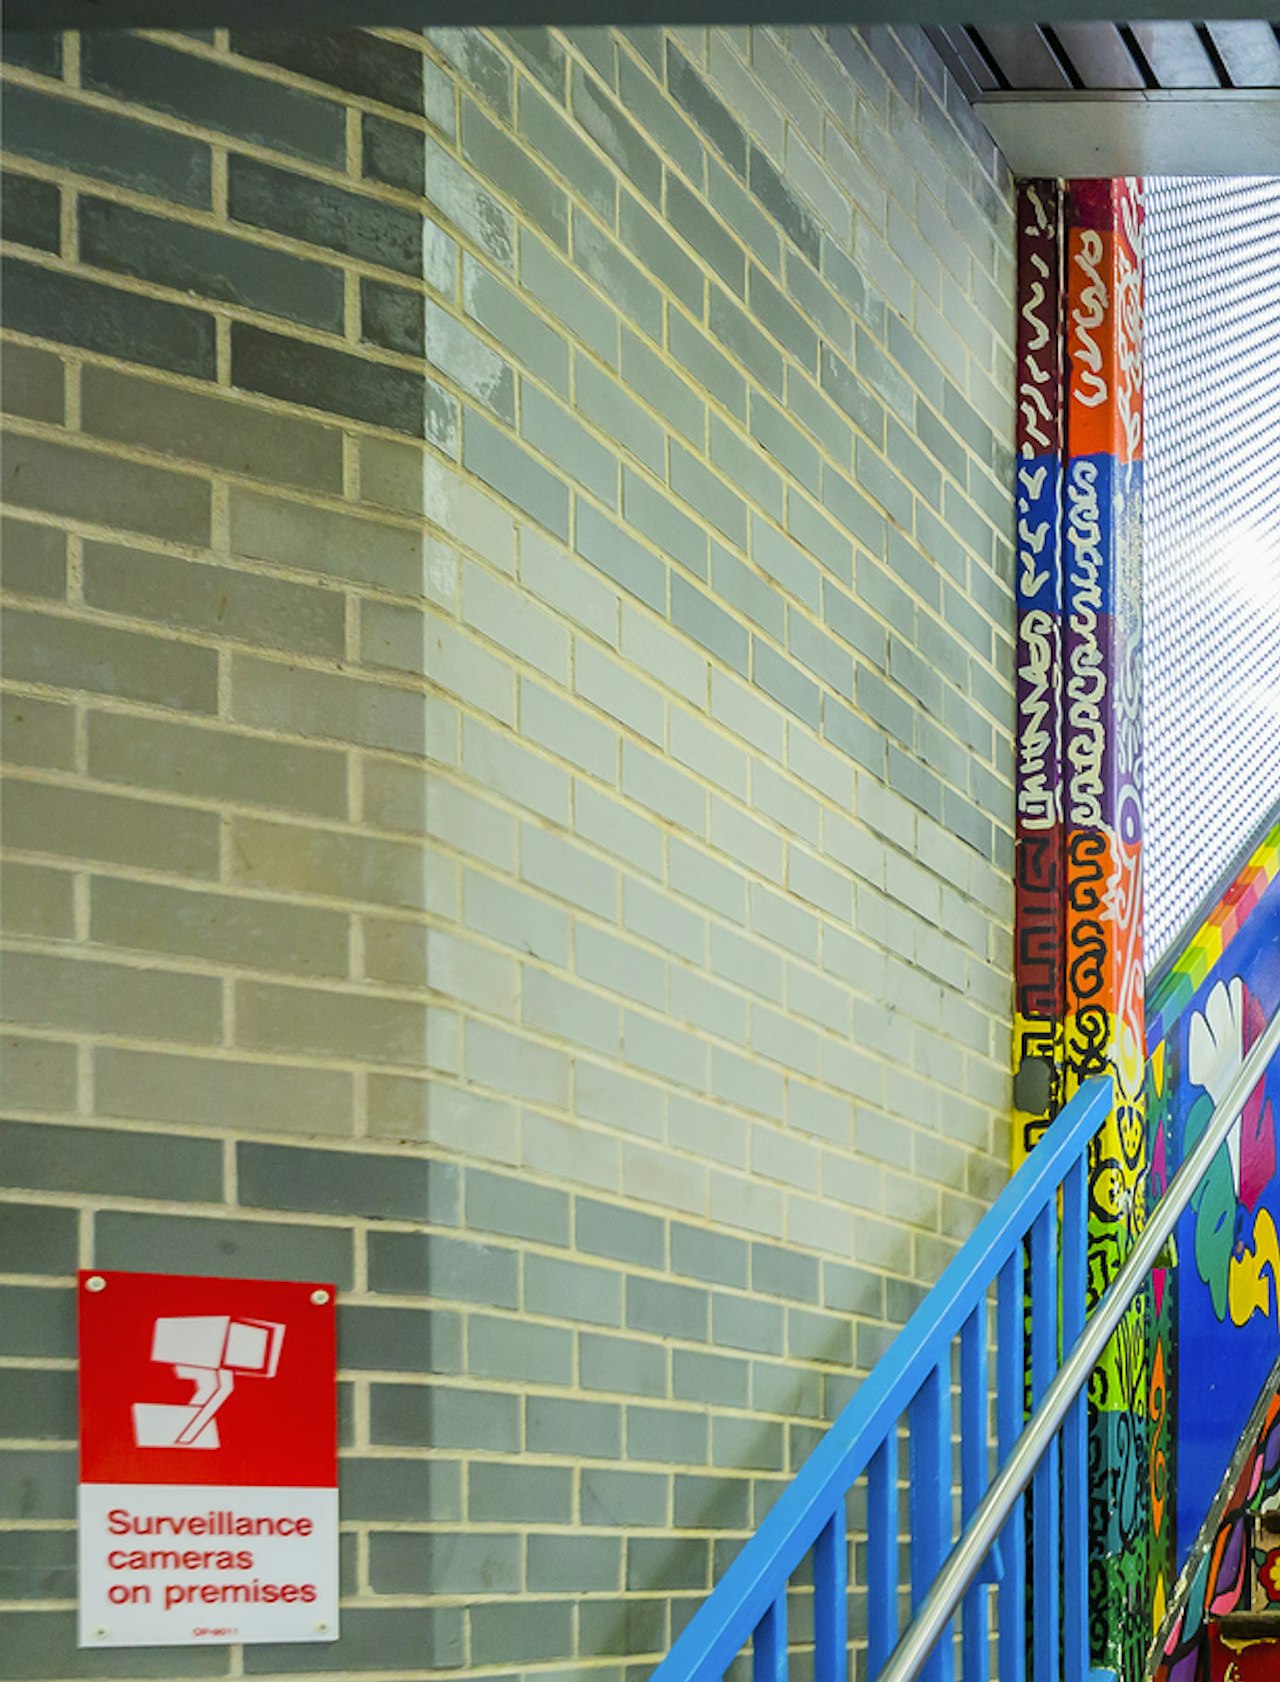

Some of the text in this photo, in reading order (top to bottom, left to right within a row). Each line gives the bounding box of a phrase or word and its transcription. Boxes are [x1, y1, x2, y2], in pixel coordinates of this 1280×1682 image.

[107, 1508, 314, 1537] Surveillance
[107, 1550, 255, 1570] cameras
[107, 1579, 318, 1611] on premises
